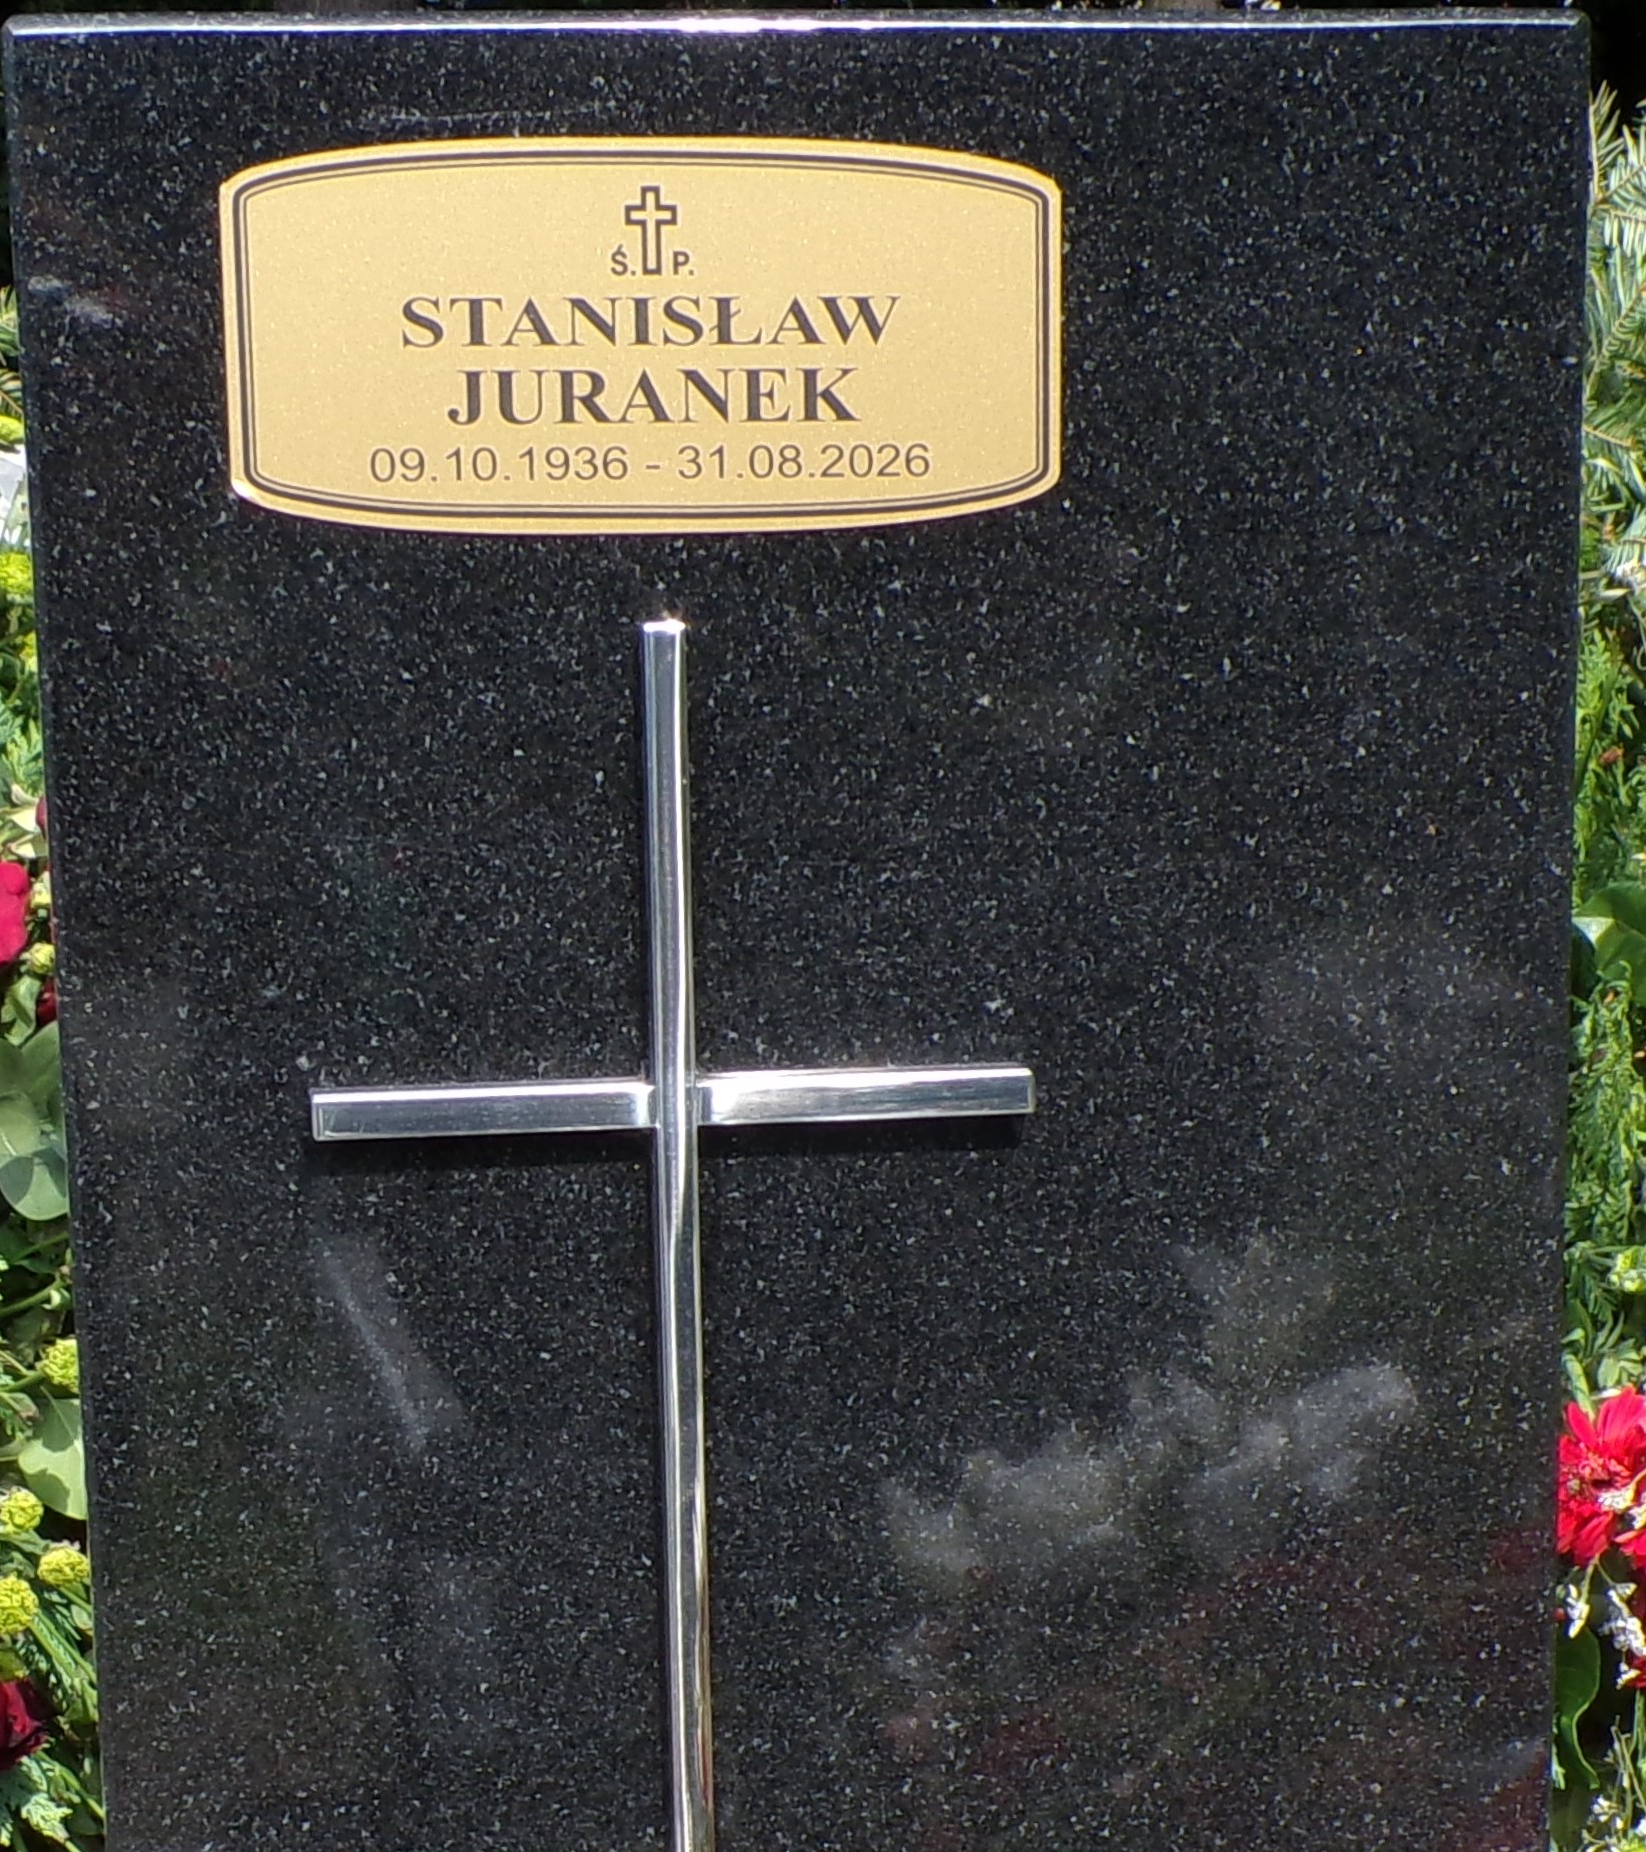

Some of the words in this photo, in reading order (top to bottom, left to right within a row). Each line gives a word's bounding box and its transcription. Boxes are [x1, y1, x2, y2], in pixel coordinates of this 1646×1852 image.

[610, 243, 636, 276] Ś.
[672, 250, 695, 276] P.
[400, 294, 900, 350] STANISŁAW
[447, 365, 861, 427] JURANEK
[369, 445, 629, 484] 09.10.1936
[677, 442, 931, 481] 31.08.2026
